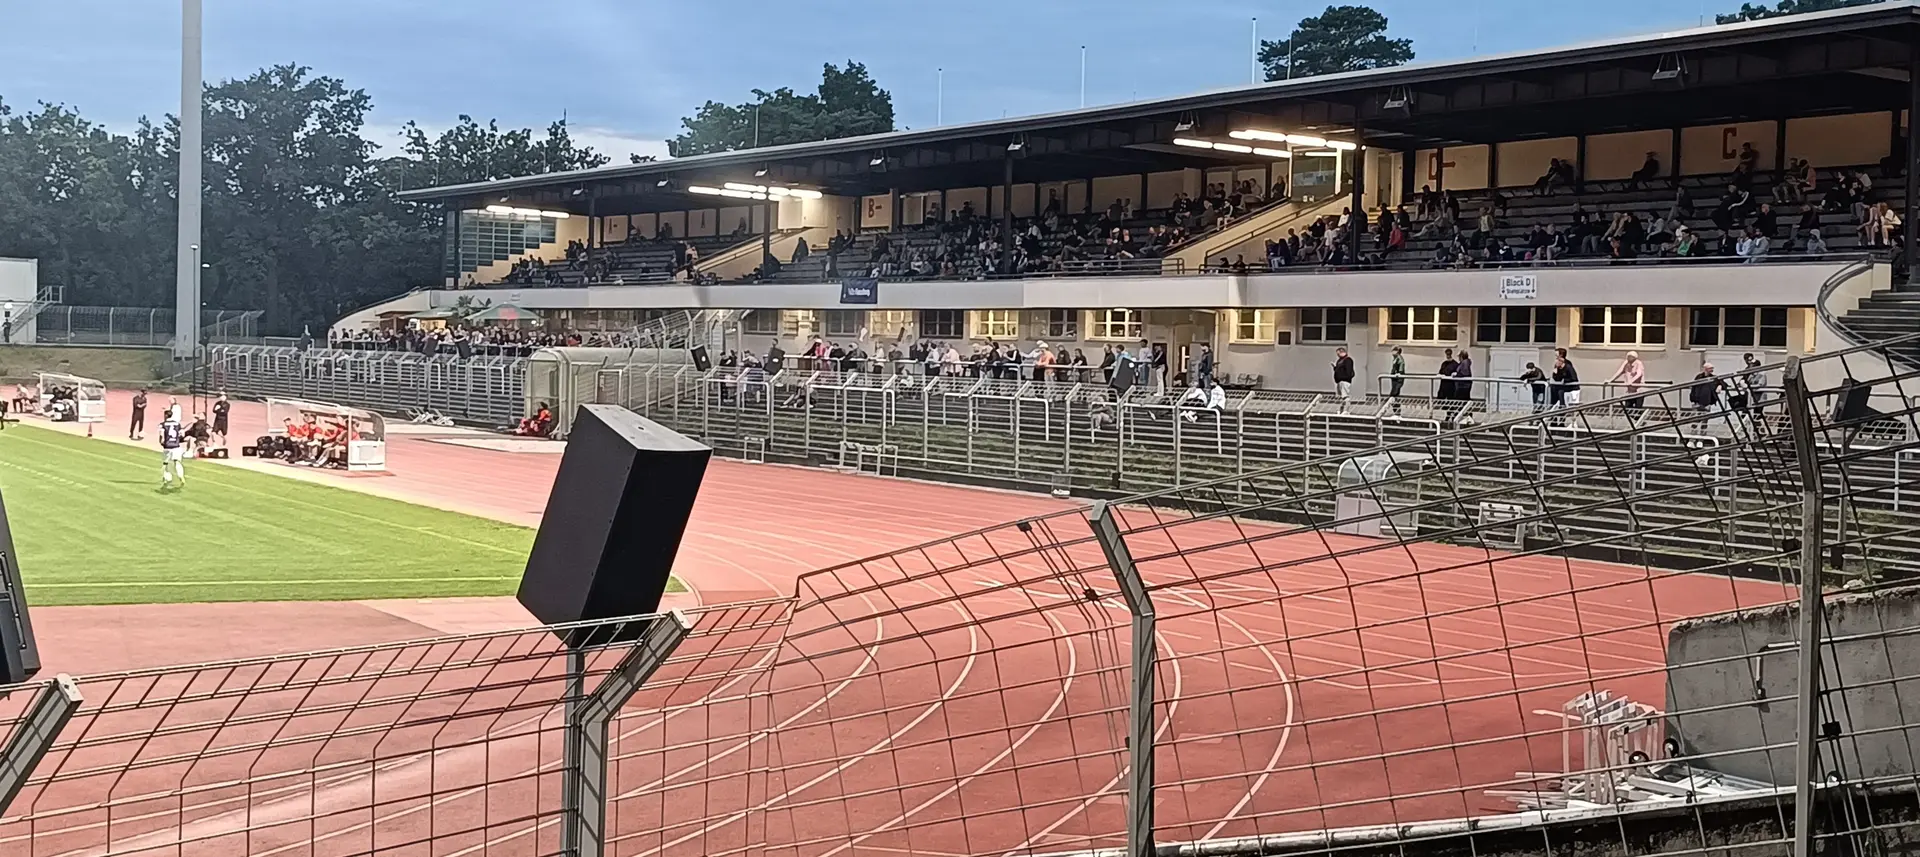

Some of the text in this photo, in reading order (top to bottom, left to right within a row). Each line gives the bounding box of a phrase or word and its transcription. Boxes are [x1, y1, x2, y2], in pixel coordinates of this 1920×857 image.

[1722, 127, 1737, 160] C
[1506, 277, 1531, 287] Block D
